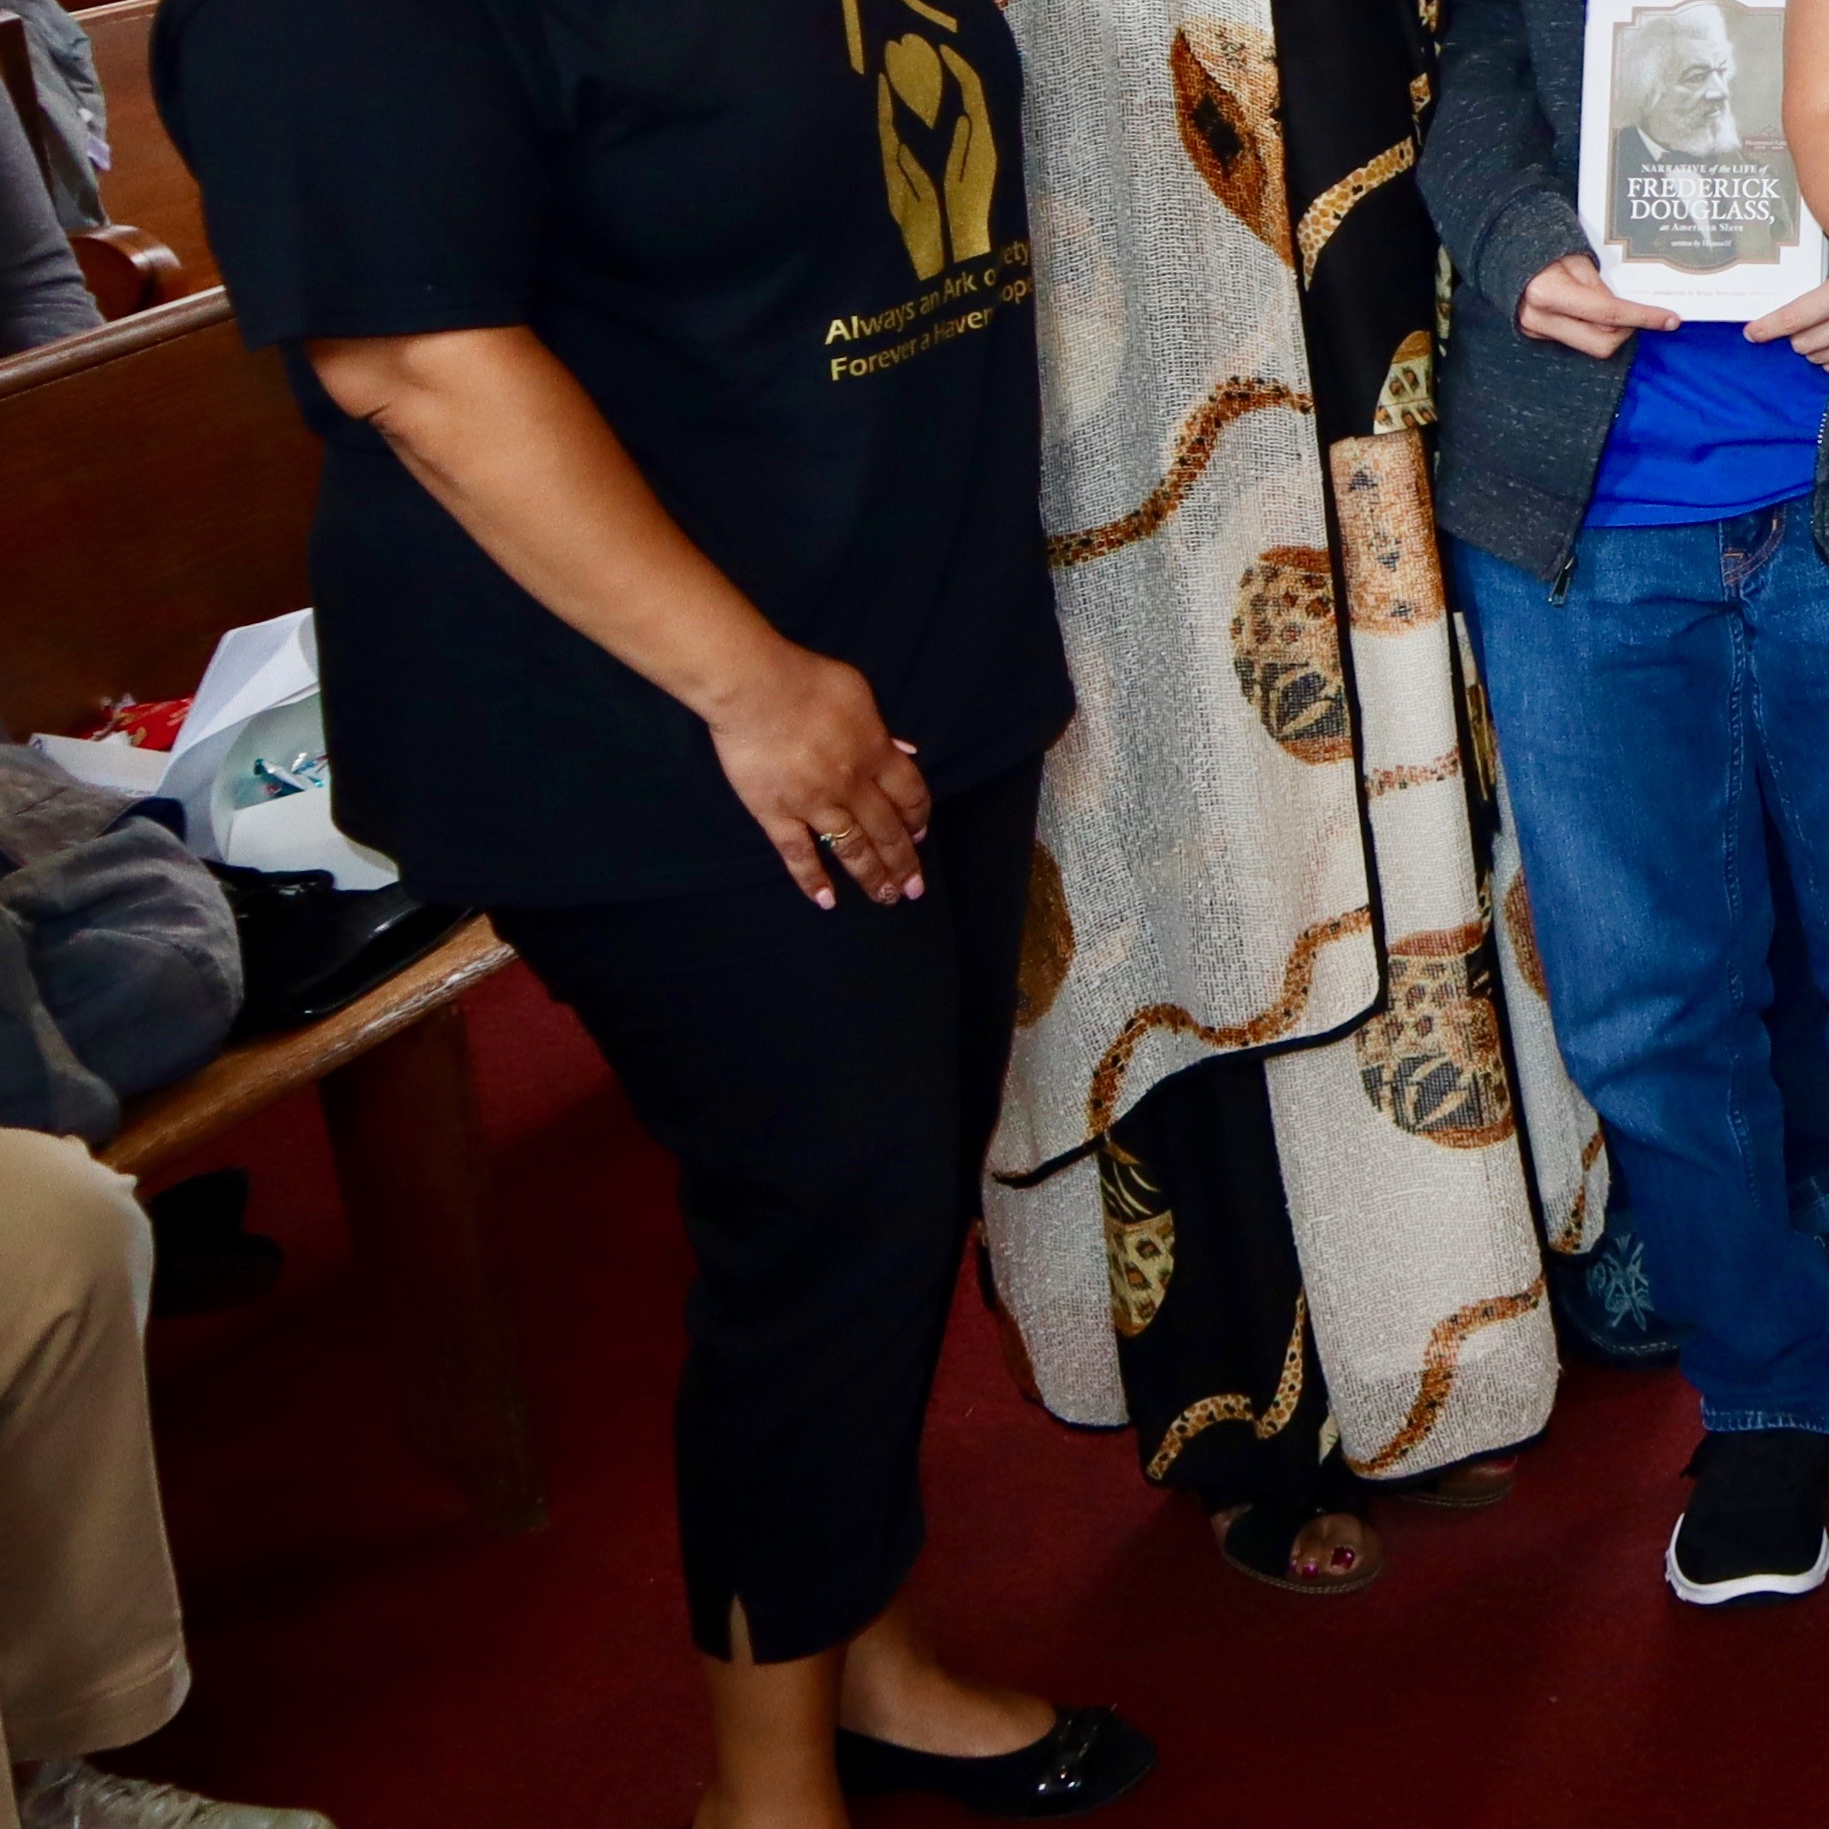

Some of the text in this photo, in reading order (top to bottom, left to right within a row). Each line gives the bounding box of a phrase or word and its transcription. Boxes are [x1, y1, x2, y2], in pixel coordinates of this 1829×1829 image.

[1641, 163, 1770, 176] NARRATIVE of the LIFE of
[1627, 177, 1780, 199] FREDERICK
[1630, 199, 1775, 225] DOUGLASS,
[1671, 223, 1717, 232] American
[1719, 223, 1744, 232] Slave
[824, 301, 915, 345] Always
[920, 291, 941, 315] an
[943, 271, 978, 303] Ark
[983, 268, 997, 287] o
[830, 337, 916, 382] Forever
[920, 332, 930, 351] a
[1002, 276, 1034, 305] op
